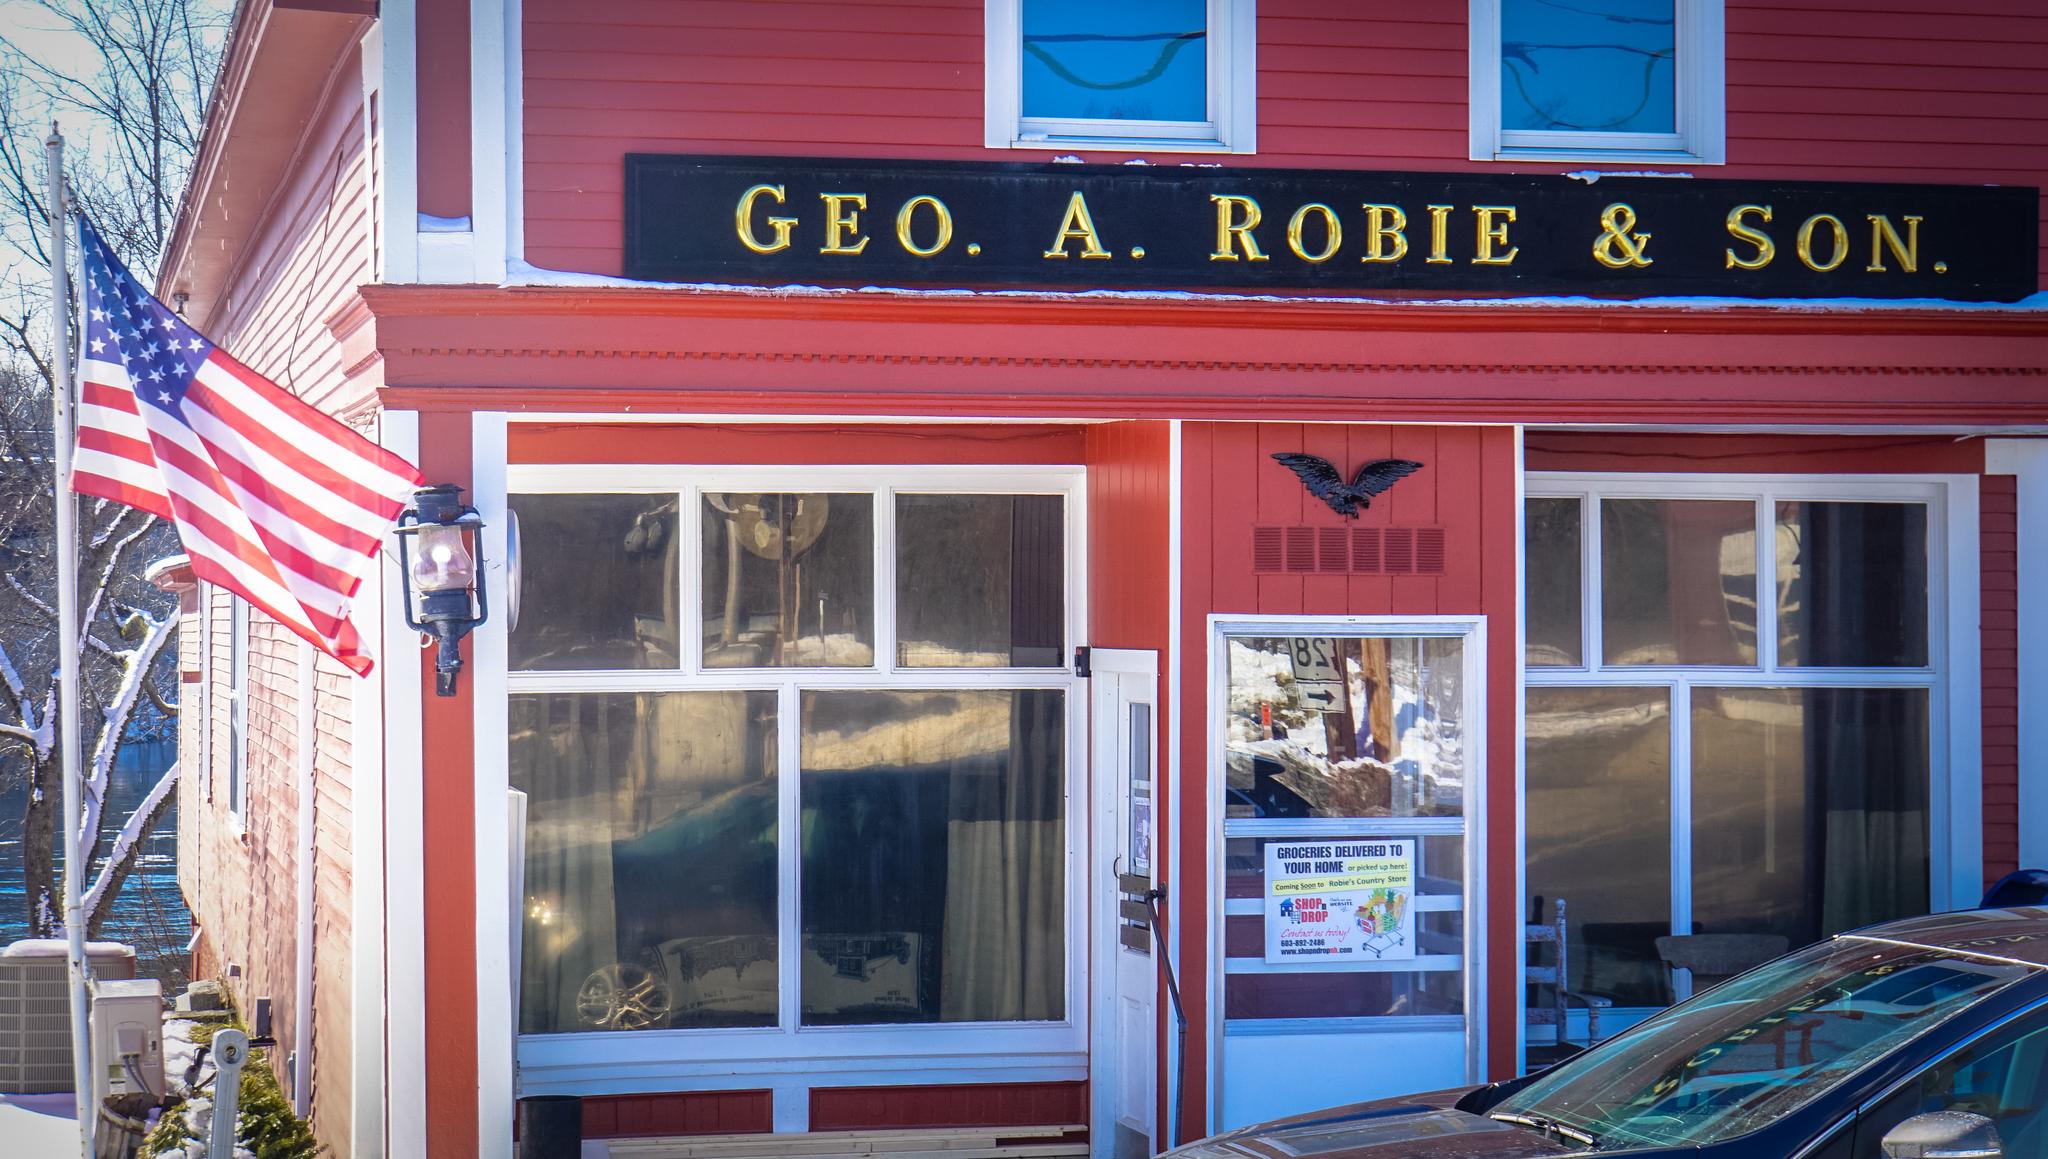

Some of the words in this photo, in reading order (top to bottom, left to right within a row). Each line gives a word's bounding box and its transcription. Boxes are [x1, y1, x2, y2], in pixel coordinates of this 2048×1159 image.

[735, 183, 982, 257] GEO.
[1044, 190, 1146, 259] A.
[1209, 193, 1519, 265] ROBIE
[1593, 202, 1654, 269] &
[1725, 204, 1948, 274] SON.
[1277, 846, 1332, 859] GROCERIES
[1335, 845, 1386, 858] DELIVERED
[1389, 844, 1403, 857] TO
[1284, 861, 1312, 874] YOUR
[1314, 861, 1344, 874] HOME
[1356, 863, 1379, 872] picked
[1380, 864, 1388, 872] up
[1389, 862, 1408, 870] here!
[1275, 883, 1299, 891] Coming
[1329, 879, 1355, 887] Robie's
[1356, 877, 1385, 886] Country
[1387, 875, 1407, 883] Store
[1295, 898, 1322, 910] SHOP
[1301, 911, 1328, 923] DROP
[1281, 928, 1313, 938] Contact
